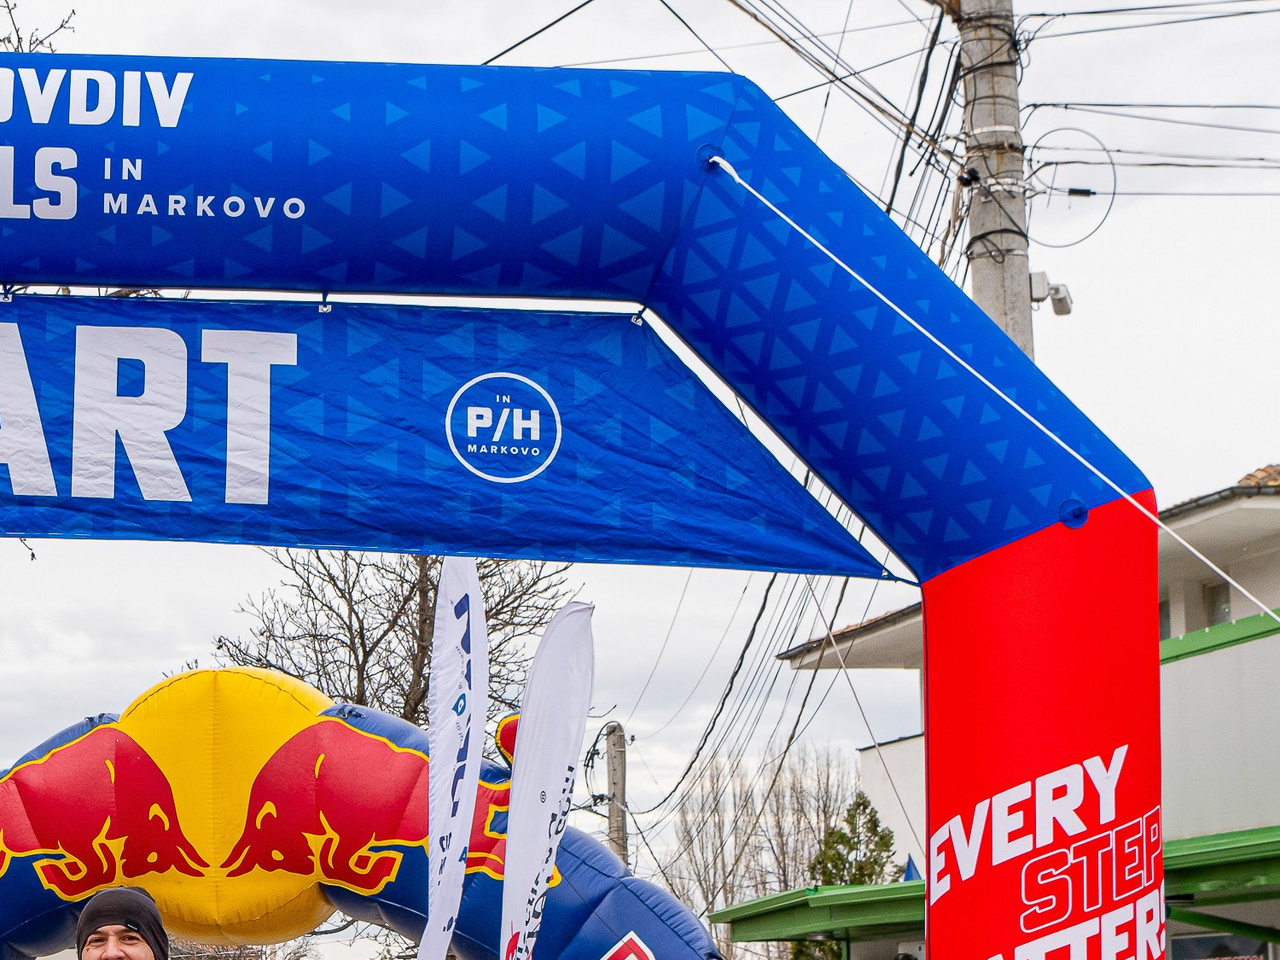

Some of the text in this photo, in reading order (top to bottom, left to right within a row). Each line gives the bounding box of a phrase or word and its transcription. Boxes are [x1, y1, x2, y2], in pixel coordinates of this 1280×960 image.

[104, 157, 142, 181] IN
[104, 193, 307, 220] MARKOVO
[496, 394, 511, 403] IN
[467, 406, 540, 442] P/H
[467, 444, 540, 456] MARKOVO
[930, 745, 1129, 906] EVERY
[1020, 805, 1162, 934] STEP
